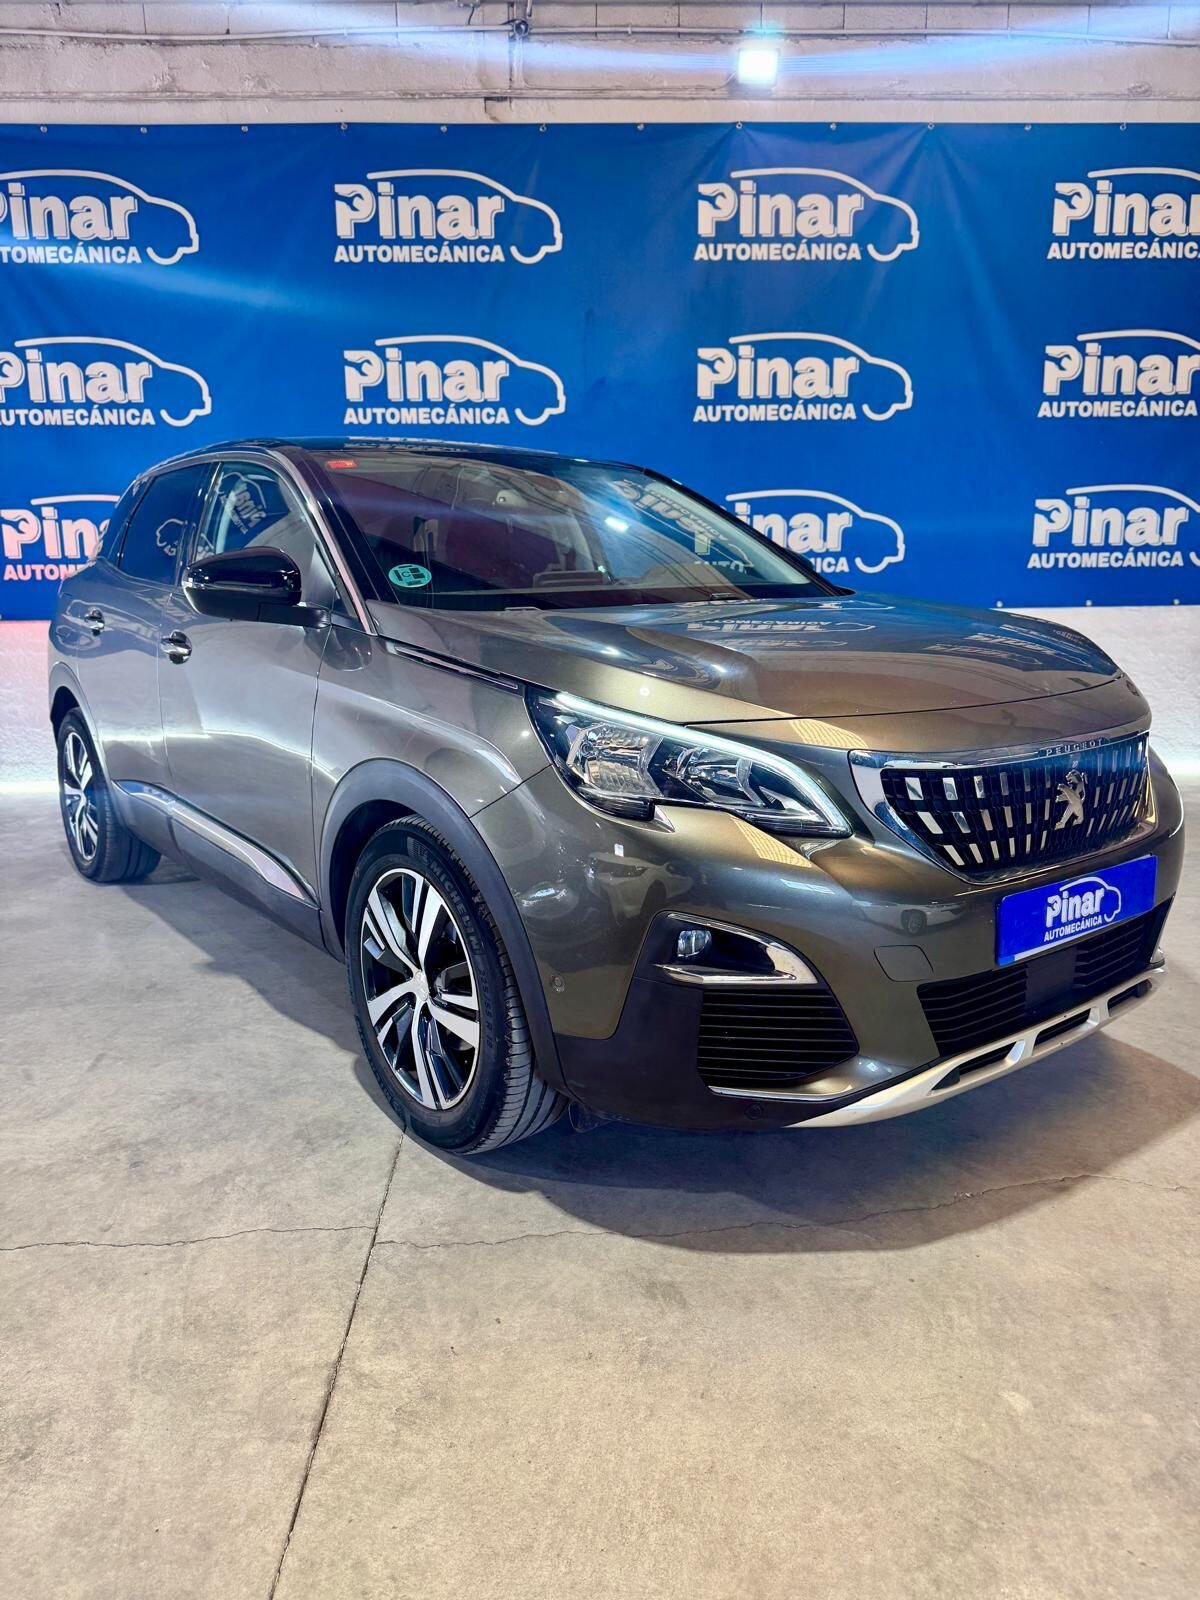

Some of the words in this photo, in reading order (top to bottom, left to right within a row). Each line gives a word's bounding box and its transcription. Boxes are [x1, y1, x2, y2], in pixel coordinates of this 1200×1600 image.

[0, 182, 138, 240] inar
[334, 181, 505, 240] Pinar
[697, 180, 865, 238] Pinar
[0, 242, 142, 264] TOMECÁNICA
[334, 241, 506, 263] AUTOMECÁNICA
[694, 239, 862, 261] AUTOMECÁNICA
[1046, 238, 1200, 260] AUTOMECÁNIC
[343, 348, 510, 403] Pinar
[697, 345, 860, 400] Pinar
[1043, 342, 1200, 396] Pinar
[0, 404, 156, 426] UTOMECÁNICA
[343, 404, 510, 425] AUTOMECÁNICA
[693, 400, 857, 422] AUTOMECÁNICA
[1036, 397, 1198, 418] AUTOMECÁNICA
[0, 506, 110, 559] Pin
[734, 502, 853, 553] nar
[1032, 496, 1189, 547] Pinar
[1027, 547, 1184, 569] AUTOMECÁNICA
[1046, 739, 1103, 757] PEUGEOT
[429, 860, 481, 952] MICHELIN
[1046, 888, 1105, 928] Pinar
[1043, 915, 1103, 942] AUTOMECÁNICA
